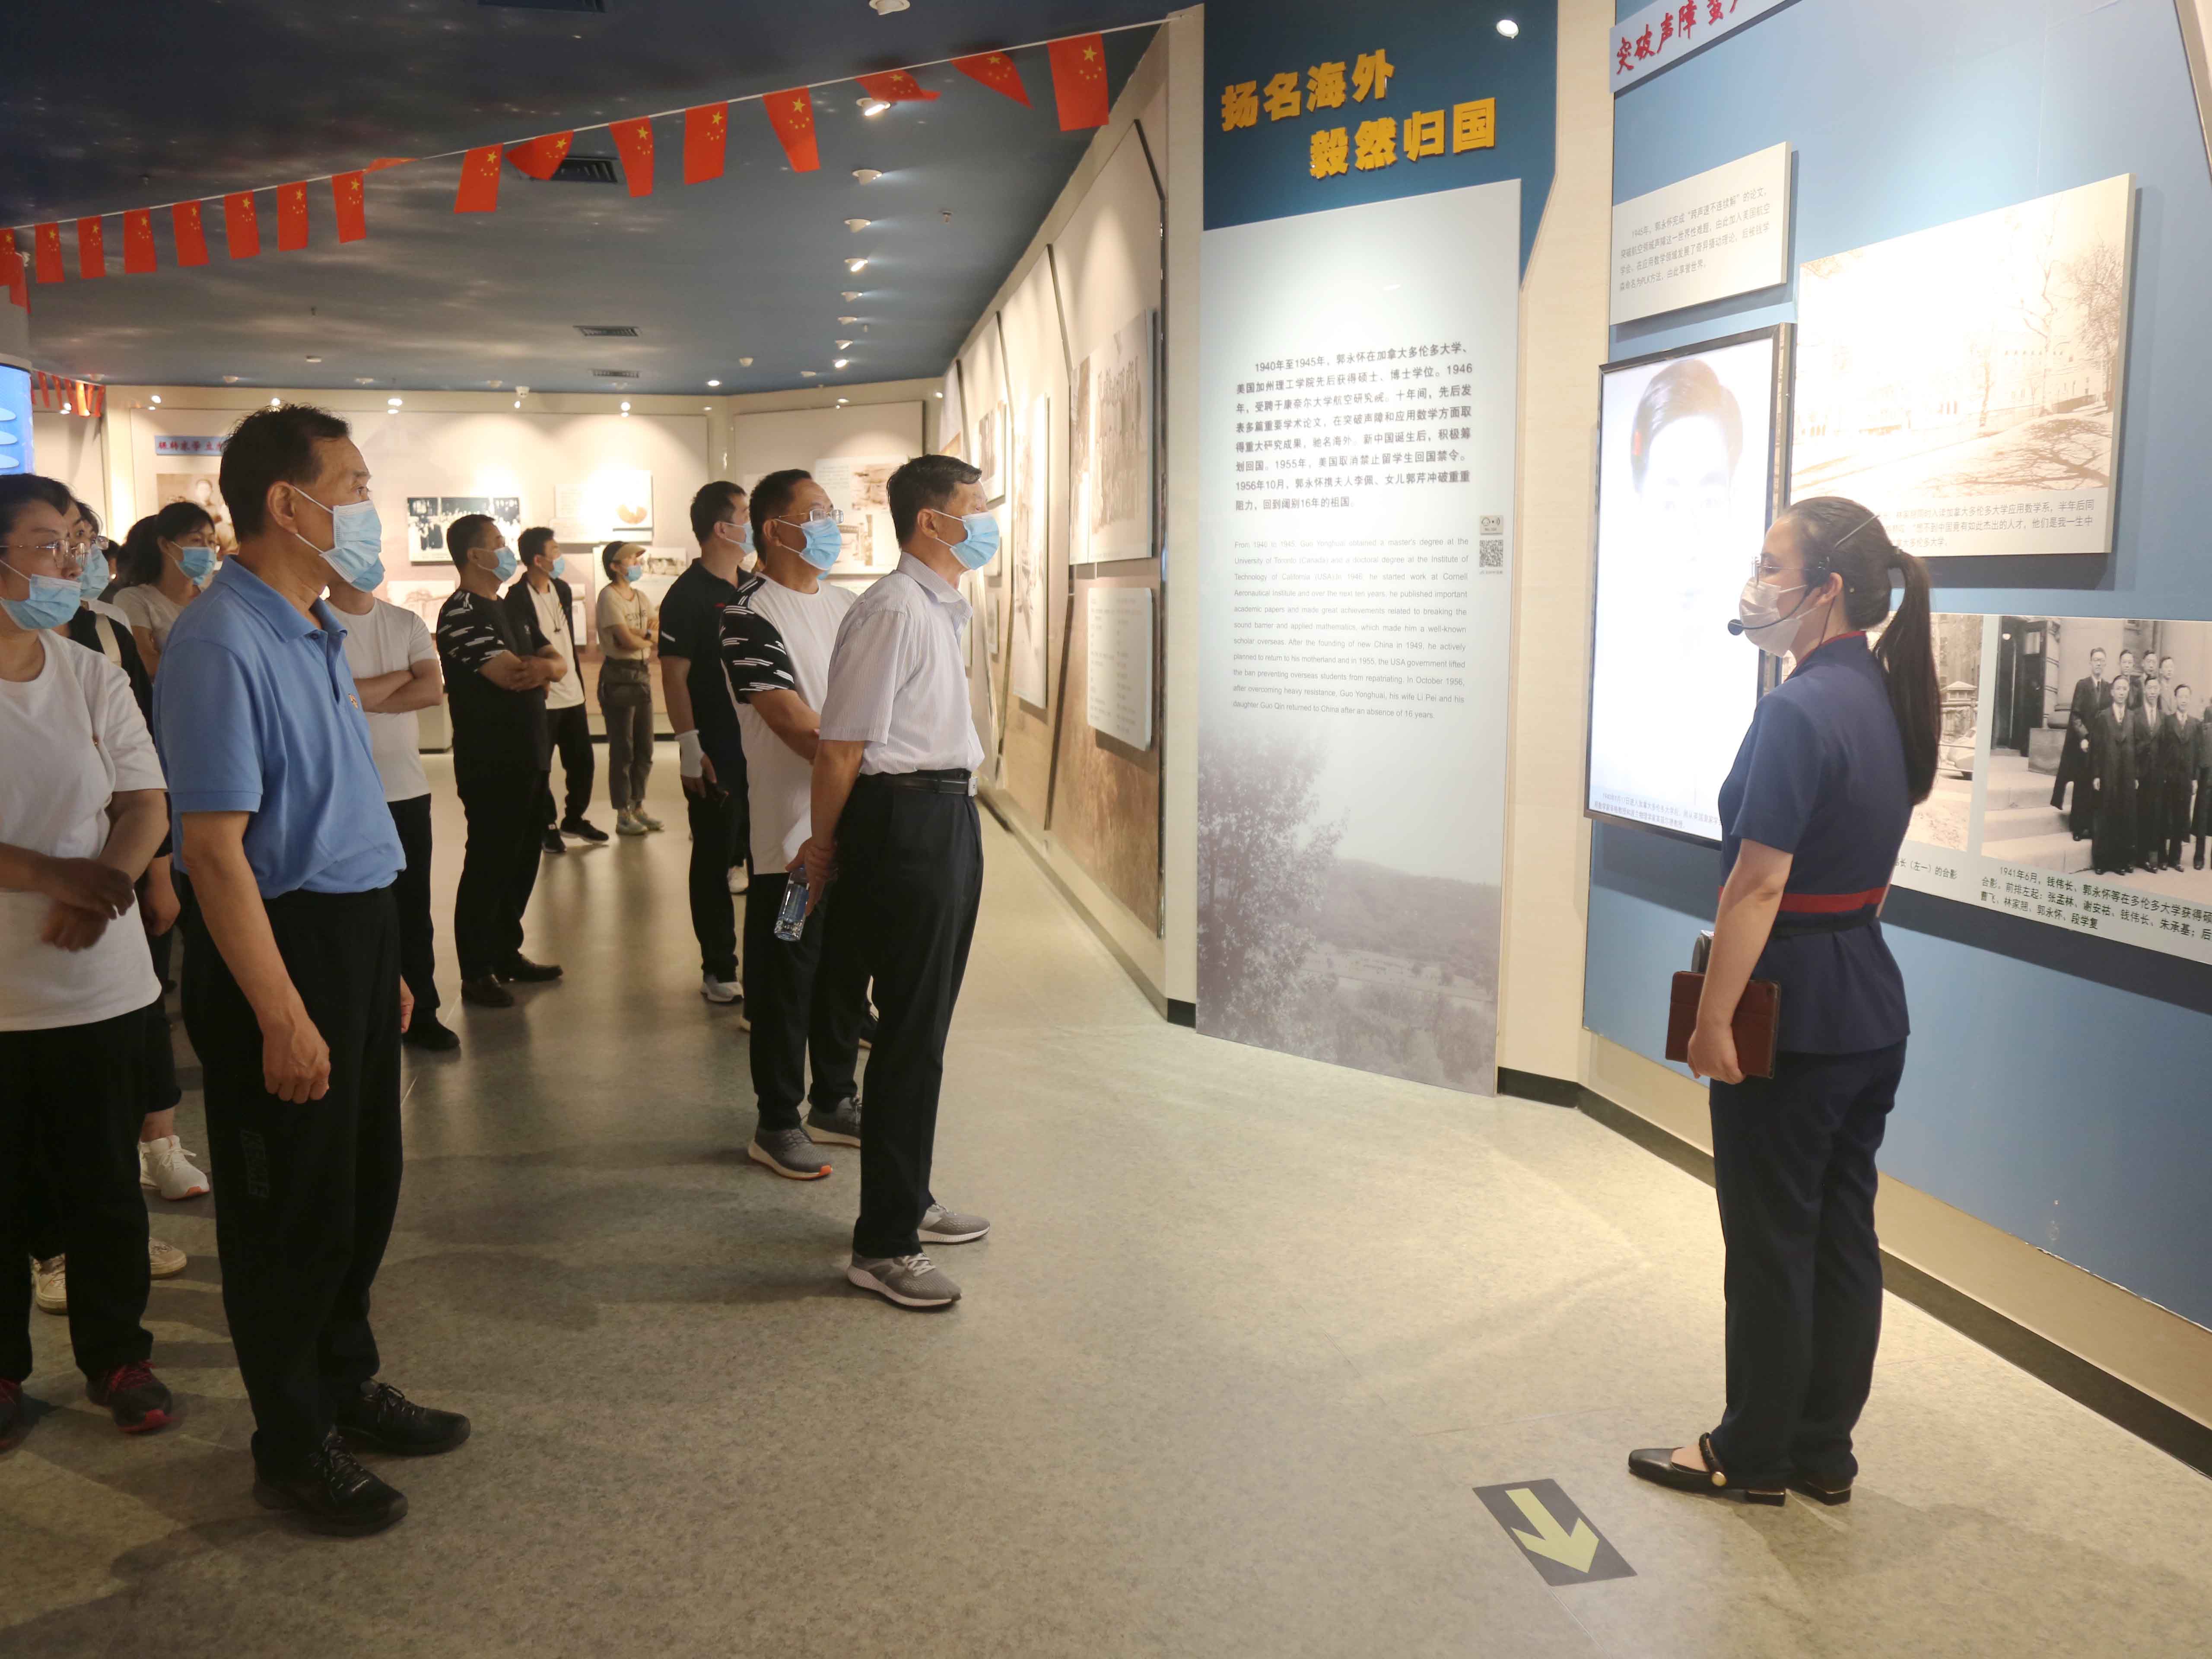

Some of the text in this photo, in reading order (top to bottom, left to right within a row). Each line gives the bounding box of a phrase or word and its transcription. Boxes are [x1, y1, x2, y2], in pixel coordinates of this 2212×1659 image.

[1221, 48, 1395, 131] 扬名海外
[1309, 97, 1496, 179] 毅然归国
[1321, 607, 1338, 615] great
[1423, 607, 1452, 617] breaking
[1291, 622, 1313, 631] applied
[1319, 639, 1345, 649] founding
[1440, 643, 1465, 652] actively
[1234, 653, 1256, 662] planned
[1257, 671, 1288, 680] preventing
[1248, 686, 1282, 696] overcoming
[1284, 687, 1302, 696] heavy
[1233, 700, 1258, 709] daughter
